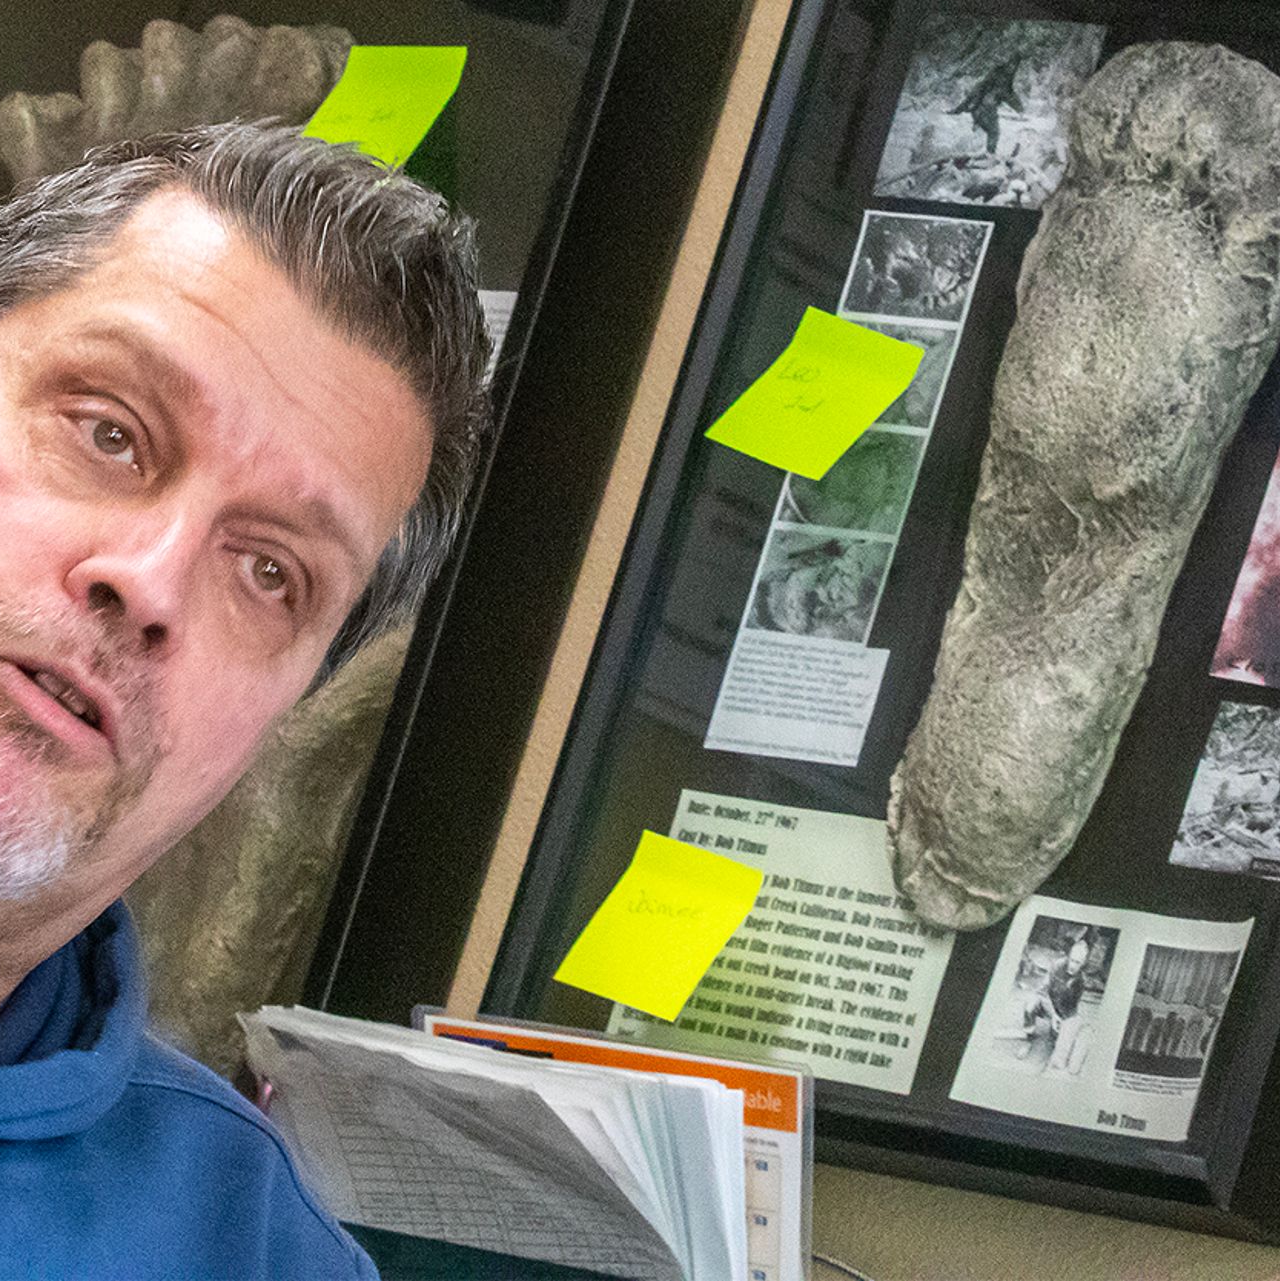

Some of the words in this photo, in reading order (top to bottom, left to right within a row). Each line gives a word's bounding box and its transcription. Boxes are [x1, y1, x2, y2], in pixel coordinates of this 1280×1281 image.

[688, 800, 712, 815] Date:
[678, 829, 697, 843] Cast
[715, 834, 734, 850] Bob
[736, 838, 768, 856] Titmus
[771, 875, 790, 890] Bob
[793, 878, 824, 895] Titmus
[838, 886, 854, 900] the
[771, 897, 797, 913] Creek
[851, 911, 872, 927] Bob
[744, 914, 773, 932] Roger
[775, 919, 822, 941] Patterson
[823, 930, 843, 944] and
[844, 932, 864, 948] Bob
[865, 936, 898, 955] Gimlin
[901, 944, 925, 958] were
[749, 937, 769, 954] film
[770, 944, 813, 962] evidence
[815, 951, 827, 963] of
[835, 954, 872, 972] Bigfoot
[874, 962, 915, 981] walking
[743, 961, 770, 977] creek
[772, 966, 798, 982] bend
[799, 972, 812, 984] on
[888, 986, 908, 1002] This
[734, 982, 746, 995] of
[840, 1000, 858, 1015] The
[860, 1006, 902, 1023] evidence
[695, 997, 722, 1013] break
[725, 1002, 754, 1019] would
[756, 1007, 795, 1026] indicate
[805, 1017, 833, 1035] living
[835, 1024, 876, 1041] creature
[879, 1031, 900, 1047] with
[725, 1026, 749, 1041] man
[749, 1029, 760, 1043] in
[770, 1035, 809, 1053] costume
[812, 1041, 833, 1058] with
[744, 1088, 782, 1113] able
[1097, 1110, 1116, 1125] Bob
